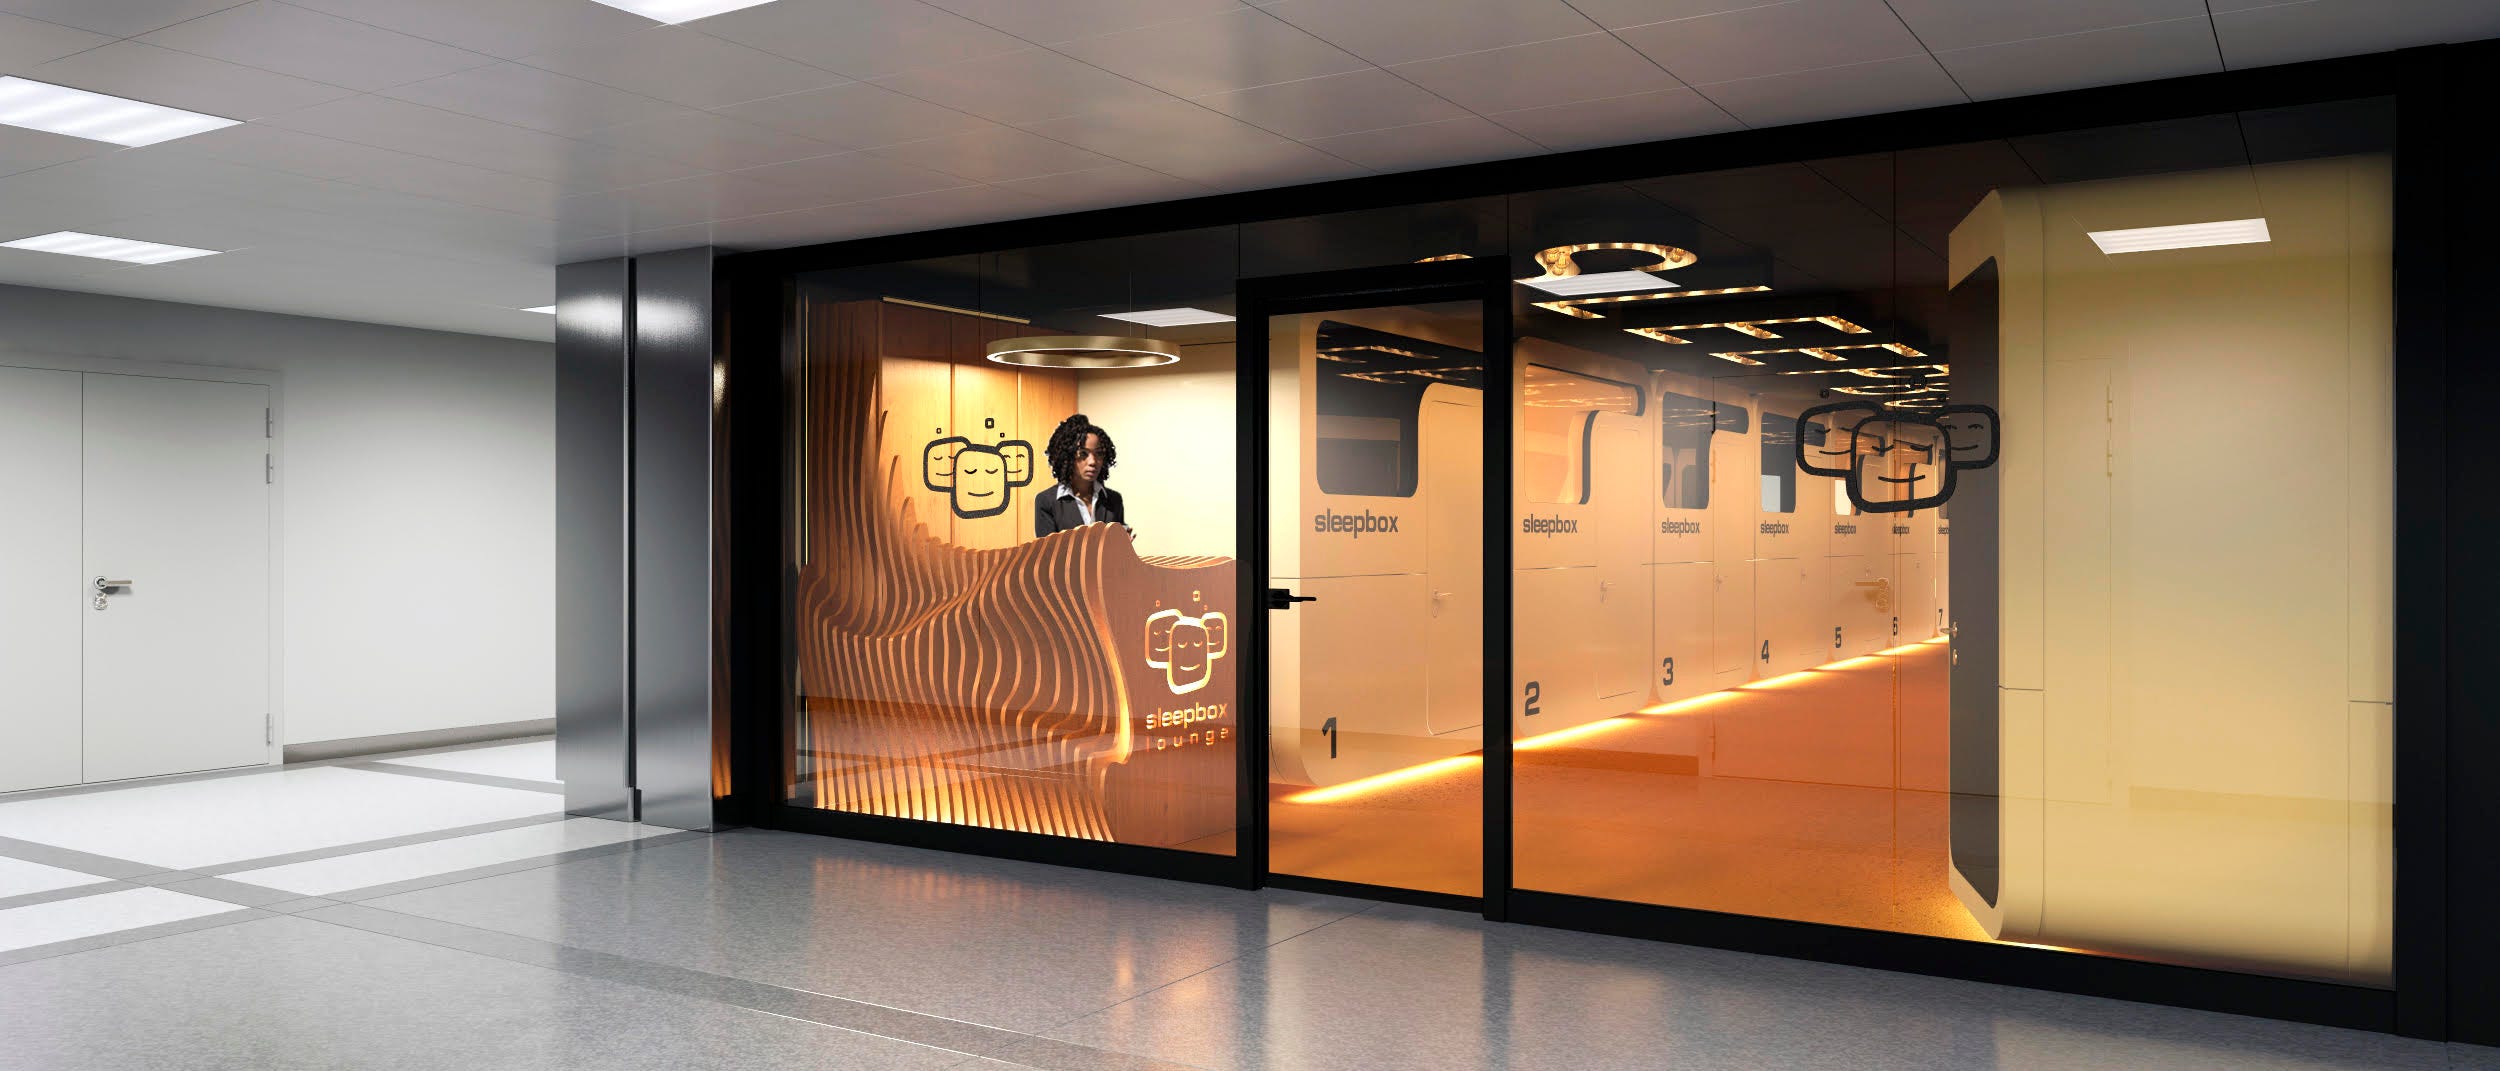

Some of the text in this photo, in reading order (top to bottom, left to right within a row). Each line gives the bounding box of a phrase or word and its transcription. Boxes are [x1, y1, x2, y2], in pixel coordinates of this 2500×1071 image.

[1315, 509, 1398, 538] sleepbox
[1523, 513, 1578, 538] sleepbox
[1662, 519, 1700, 538] sleepbox
[1760, 520, 1790, 537] sleepbox
[1938, 608, 1944, 626] 7
[1834, 626, 1843, 649] 5
[1760, 639, 1771, 664] 4
[1662, 656, 1675, 686] 3
[1524, 680, 1541, 717] 2
[1146, 702, 1228, 731] sleepbox
[1147, 726, 1228, 752] lounge
[1321, 716, 1338, 759] 1
